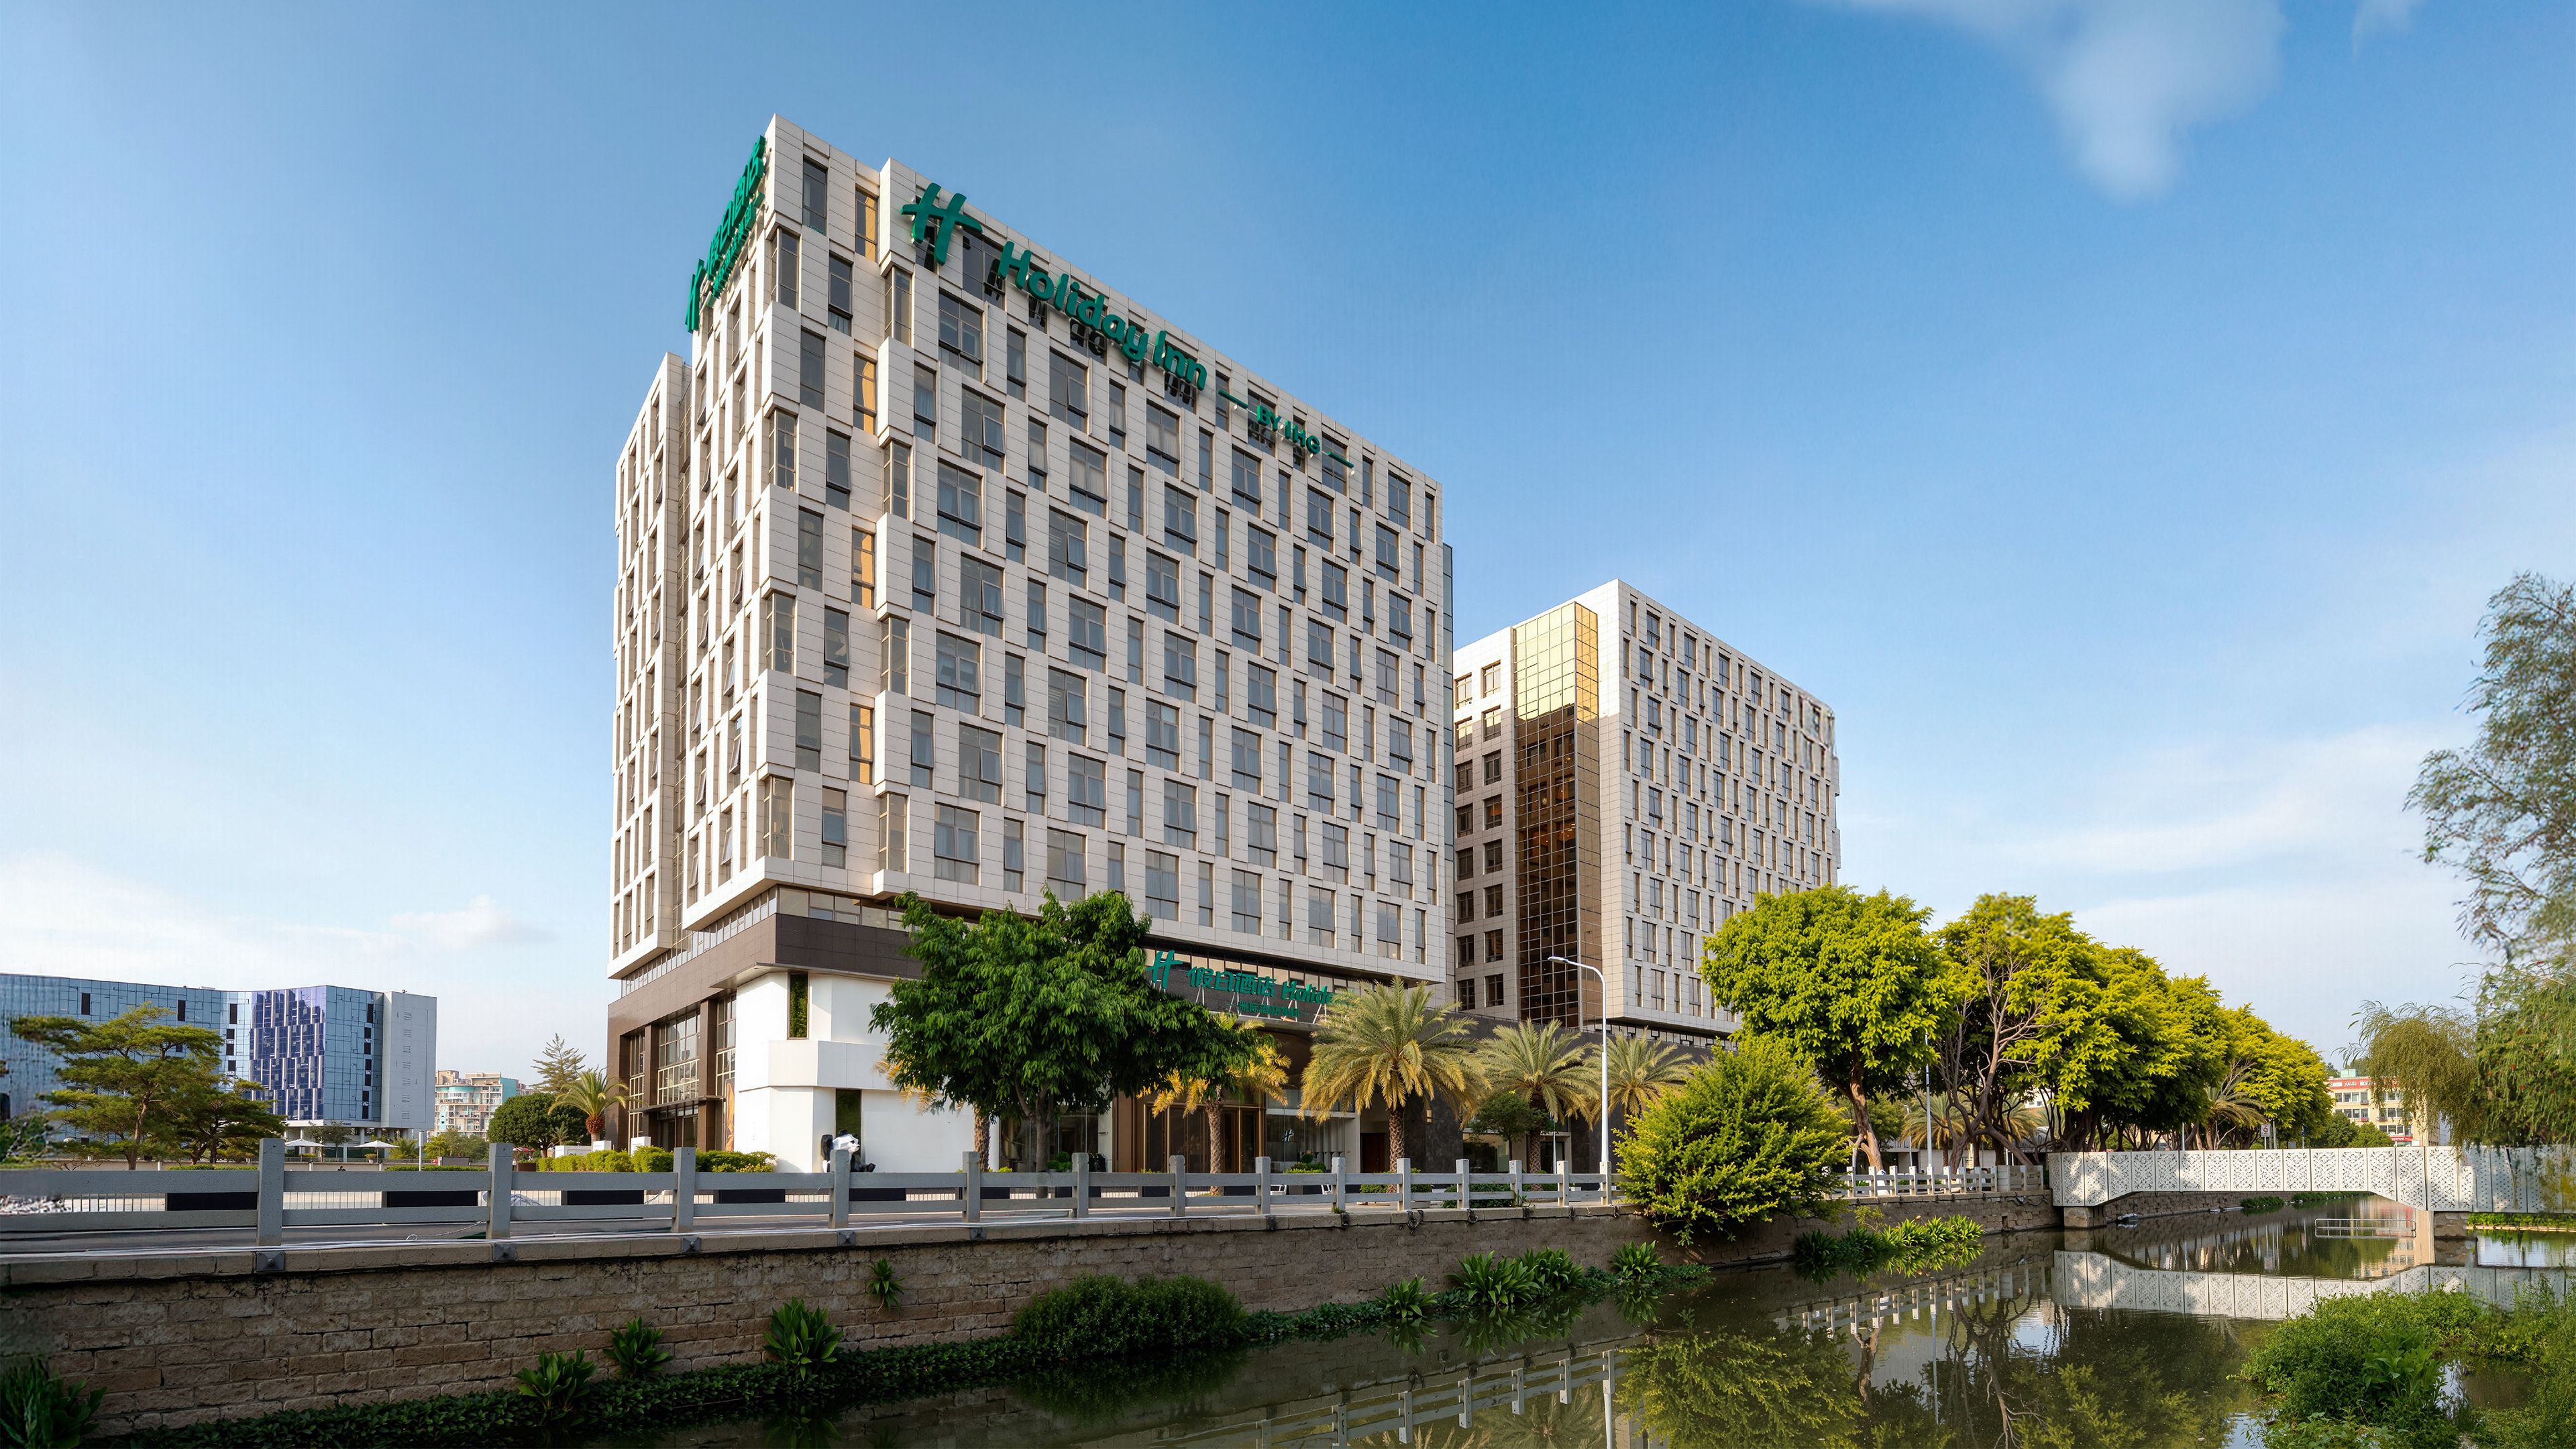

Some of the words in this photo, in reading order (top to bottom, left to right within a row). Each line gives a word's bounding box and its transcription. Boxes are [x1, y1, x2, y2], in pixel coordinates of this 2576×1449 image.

[997, 241, 1149, 363] Holiday
[1152, 330, 1208, 390] Inn
[1256, 405, 1282, 432] BY
[1285, 420, 1321, 455] IHG
[1186, 967, 1277, 998] 假日酒店
[1281, 981, 1336, 1004] Holid
